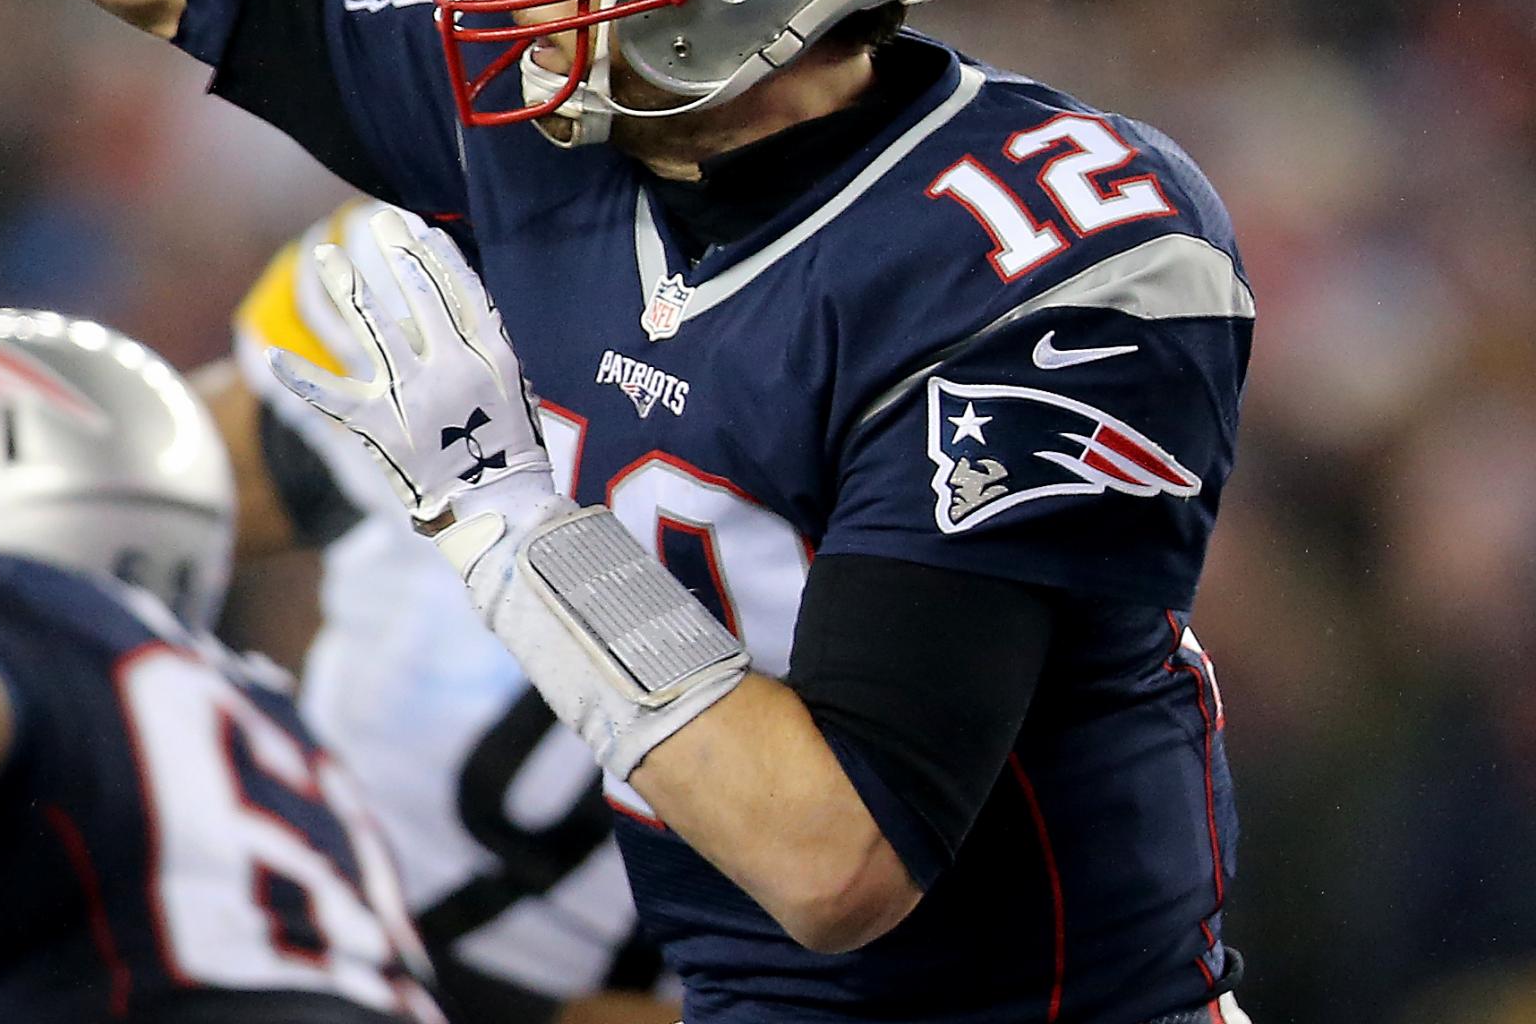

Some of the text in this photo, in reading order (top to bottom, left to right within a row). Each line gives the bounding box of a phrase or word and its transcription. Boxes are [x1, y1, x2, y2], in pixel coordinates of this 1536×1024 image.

[924, 113, 1178, 283] 12
[650, 301, 675, 328] NFL
[595, 350, 690, 416] PATRIOTS
